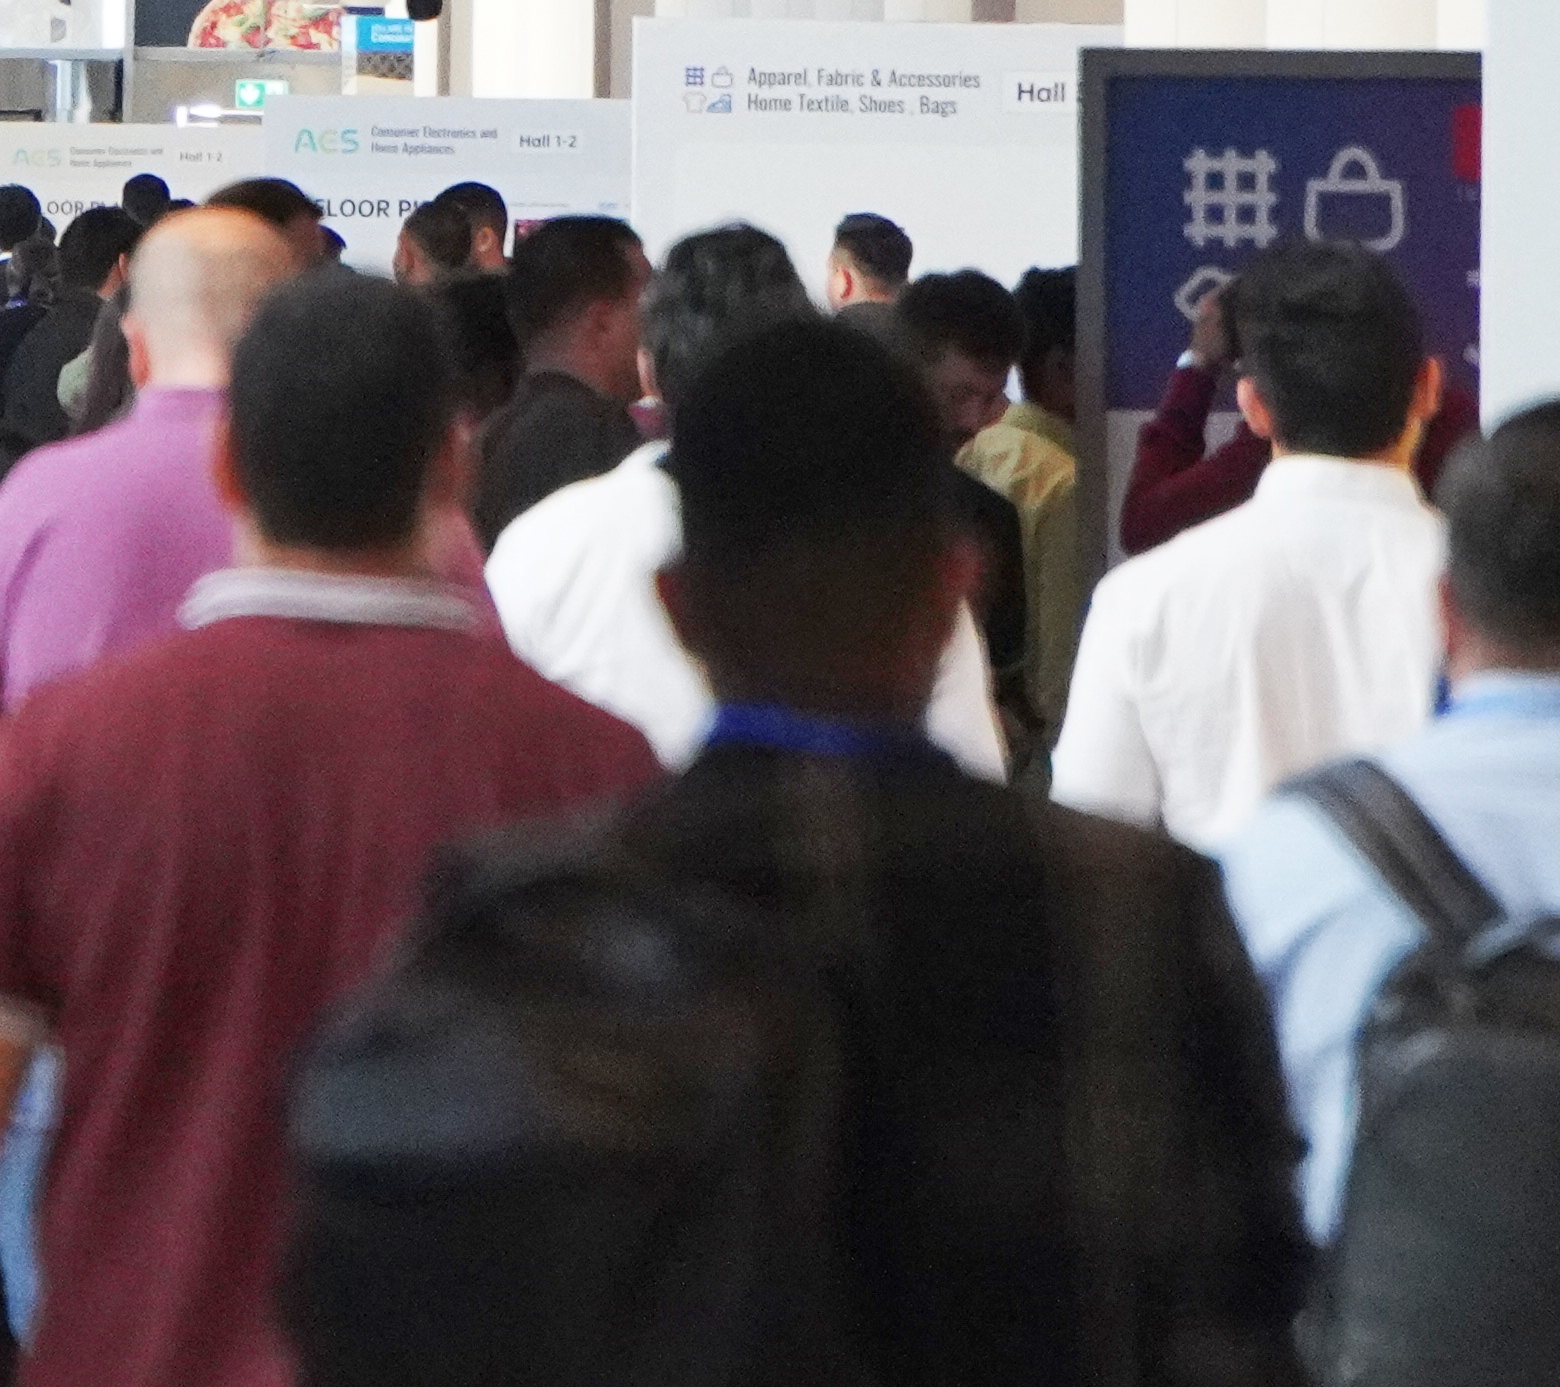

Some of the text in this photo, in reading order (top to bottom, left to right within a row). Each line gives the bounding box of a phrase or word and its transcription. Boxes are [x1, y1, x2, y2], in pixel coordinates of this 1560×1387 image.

[816, 68, 981, 90] Fabric & Accessories
[1016, 82, 1066, 103] Hall
[747, 94, 958, 117] Home Shoes Bags
[519, 134, 578, 149] Hall 1-2
